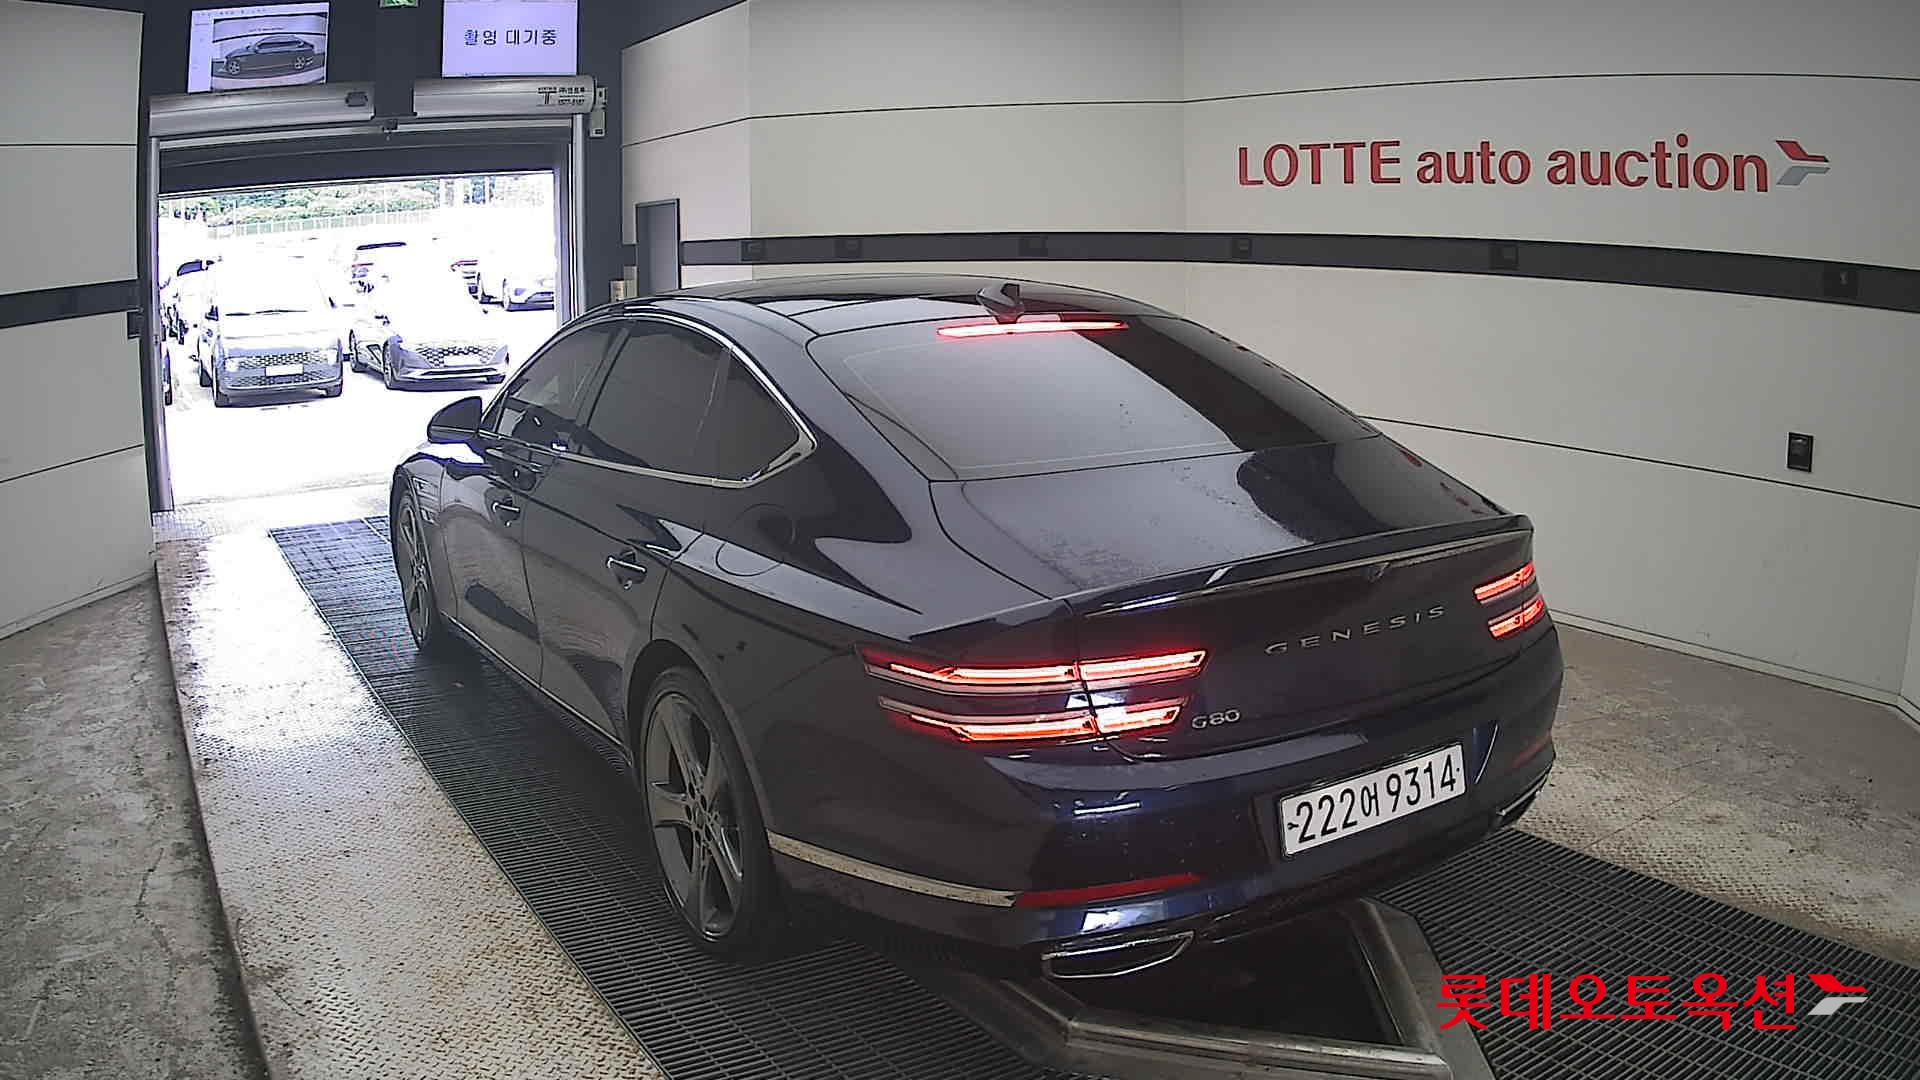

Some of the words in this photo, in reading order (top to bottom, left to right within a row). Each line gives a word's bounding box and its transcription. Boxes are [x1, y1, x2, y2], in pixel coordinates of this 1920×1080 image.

[464, 29, 497, 46] 촬영
[505, 29, 557, 46] 대기중
[1239, 141, 1400, 187] LOTTE
[1416, 140, 1531, 186] auto
[1546, 133, 1769, 193] auction
[1264, 605, 1445, 655] GENESIS
[1191, 709, 1241, 730] G80
